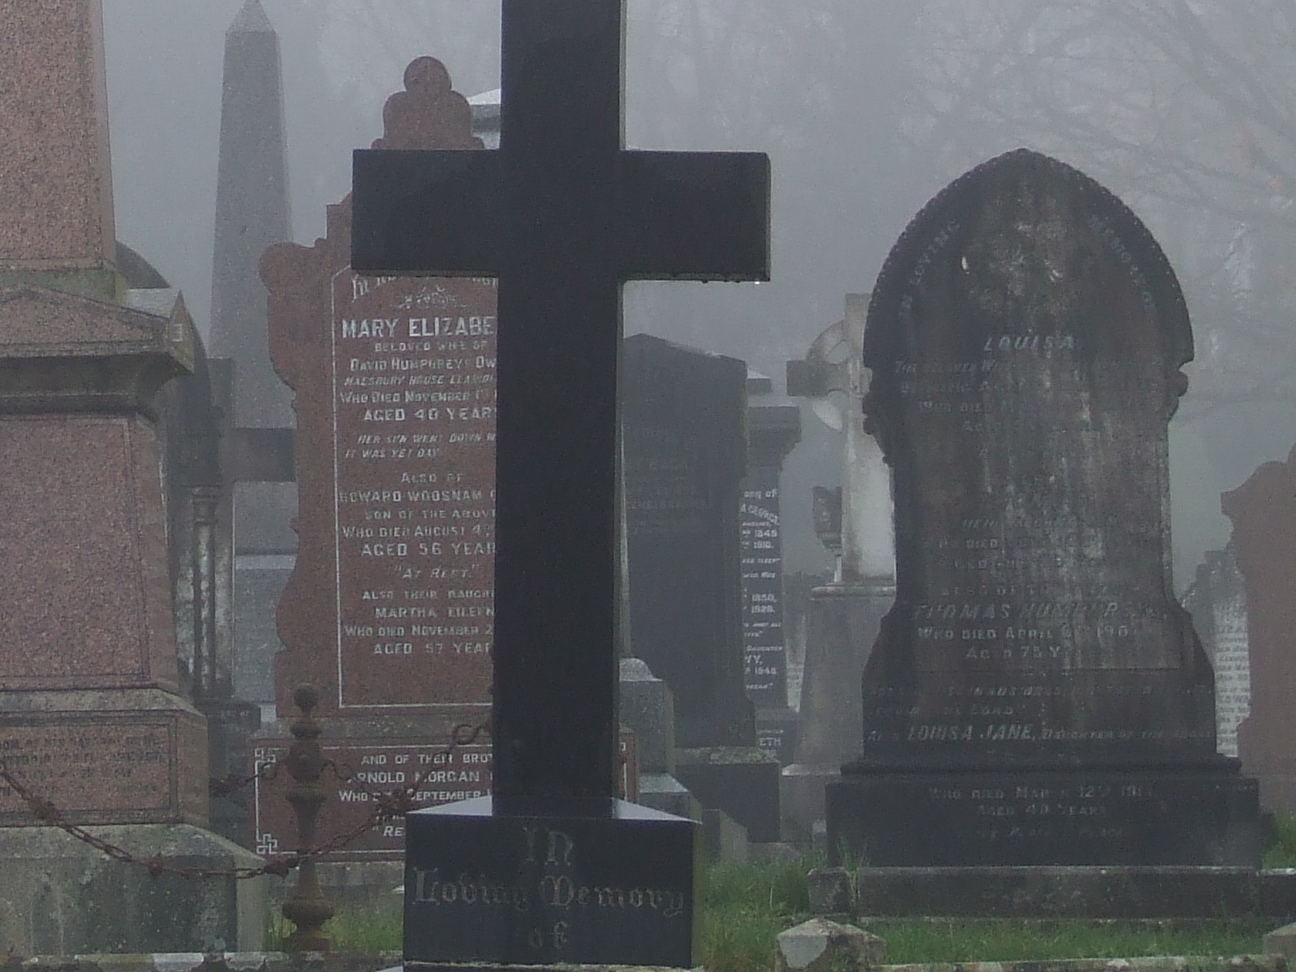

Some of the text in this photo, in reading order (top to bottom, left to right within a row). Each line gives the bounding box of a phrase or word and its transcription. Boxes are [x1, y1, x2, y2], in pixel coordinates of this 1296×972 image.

[342, 316, 496, 338] MARY ELIZABE
[375, 340, 488, 352] BELOVED WIFE OF
[983, 334, 1075, 352] LOUISA
[351, 358, 387, 371] DAVID
[340, 391, 369, 403] WHO
[372, 391, 401, 402] DIED
[405, 390, 470, 402] NOVEMBER
[364, 409, 405, 421] AGED
[446, 407, 496, 420] YEAR
[358, 434, 381, 444] HER
[362, 448, 386, 458] WAS
[391, 448, 412, 458] YET
[407, 489, 482, 502] WOOSNAM
[365, 510, 392, 520] SON
[399, 509, 414, 520] OF
[422, 509, 446, 519] THE
[342, 524, 466, 538] WHO DIED AUGUST
[361, 542, 408, 556] AGED
[419, 542, 442, 556] 56
[362, 590, 394, 600] ALSO
[404, 590, 438, 600] THEIR
[375, 606, 437, 618] MARTHA
[343, 626, 373, 637] WHO
[378, 626, 404, 636] DIED
[411, 625, 479, 636] NOVEMBER
[374, 643, 412, 654] AGED
[907, 724, 973, 741] LOUISA
[979, 723, 1037, 742] JANE,
[361, 755, 387, 765] AND
[394, 754, 409, 765] OF
[347, 771, 405, 784] RNOLD
[339, 790, 368, 802] WHO
[411, 866, 685, 919] Loving Memory
